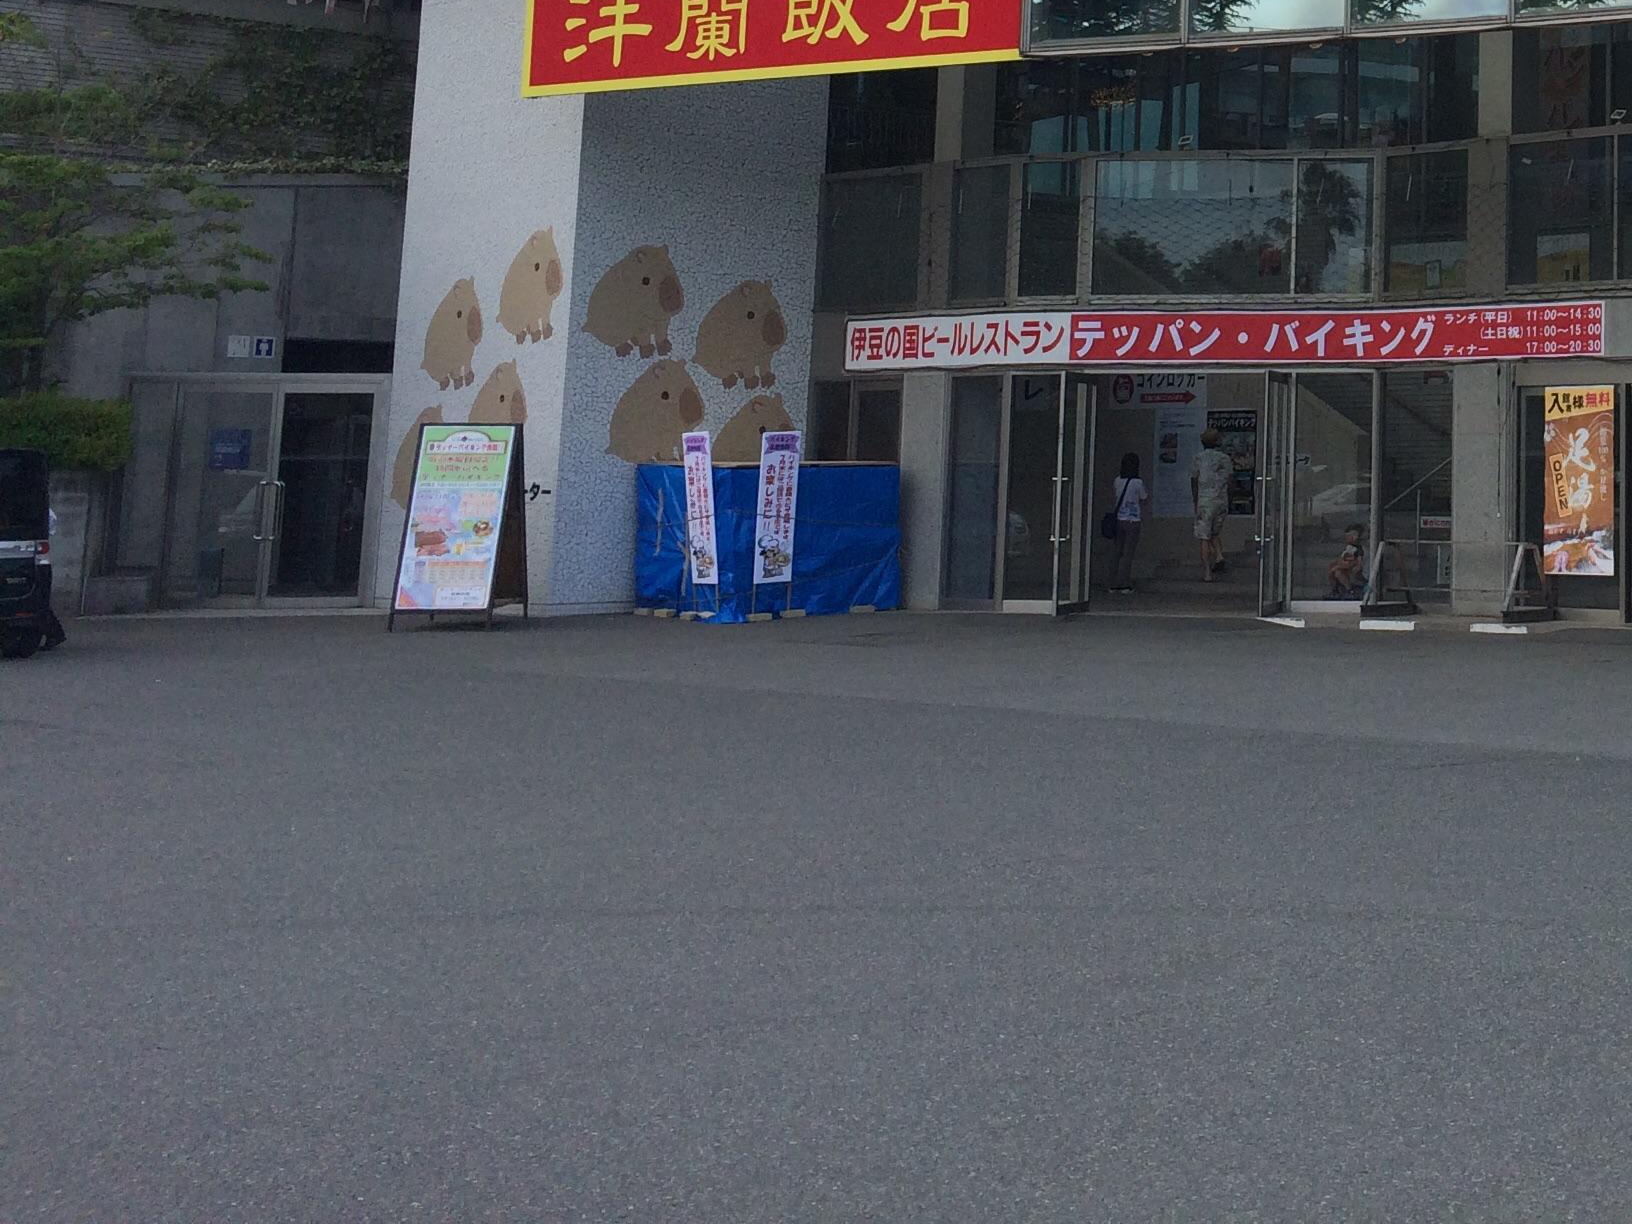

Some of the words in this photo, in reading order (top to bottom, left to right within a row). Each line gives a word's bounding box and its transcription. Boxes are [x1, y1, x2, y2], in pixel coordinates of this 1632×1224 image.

[850, 319, 1064, 361] 伊豆の国ビールレストラン
[1073, 315, 1436, 357] テッパン・バイキング
[1443, 343, 1489, 356] ディナー
[1553, 459, 1569, 511] OPEN
